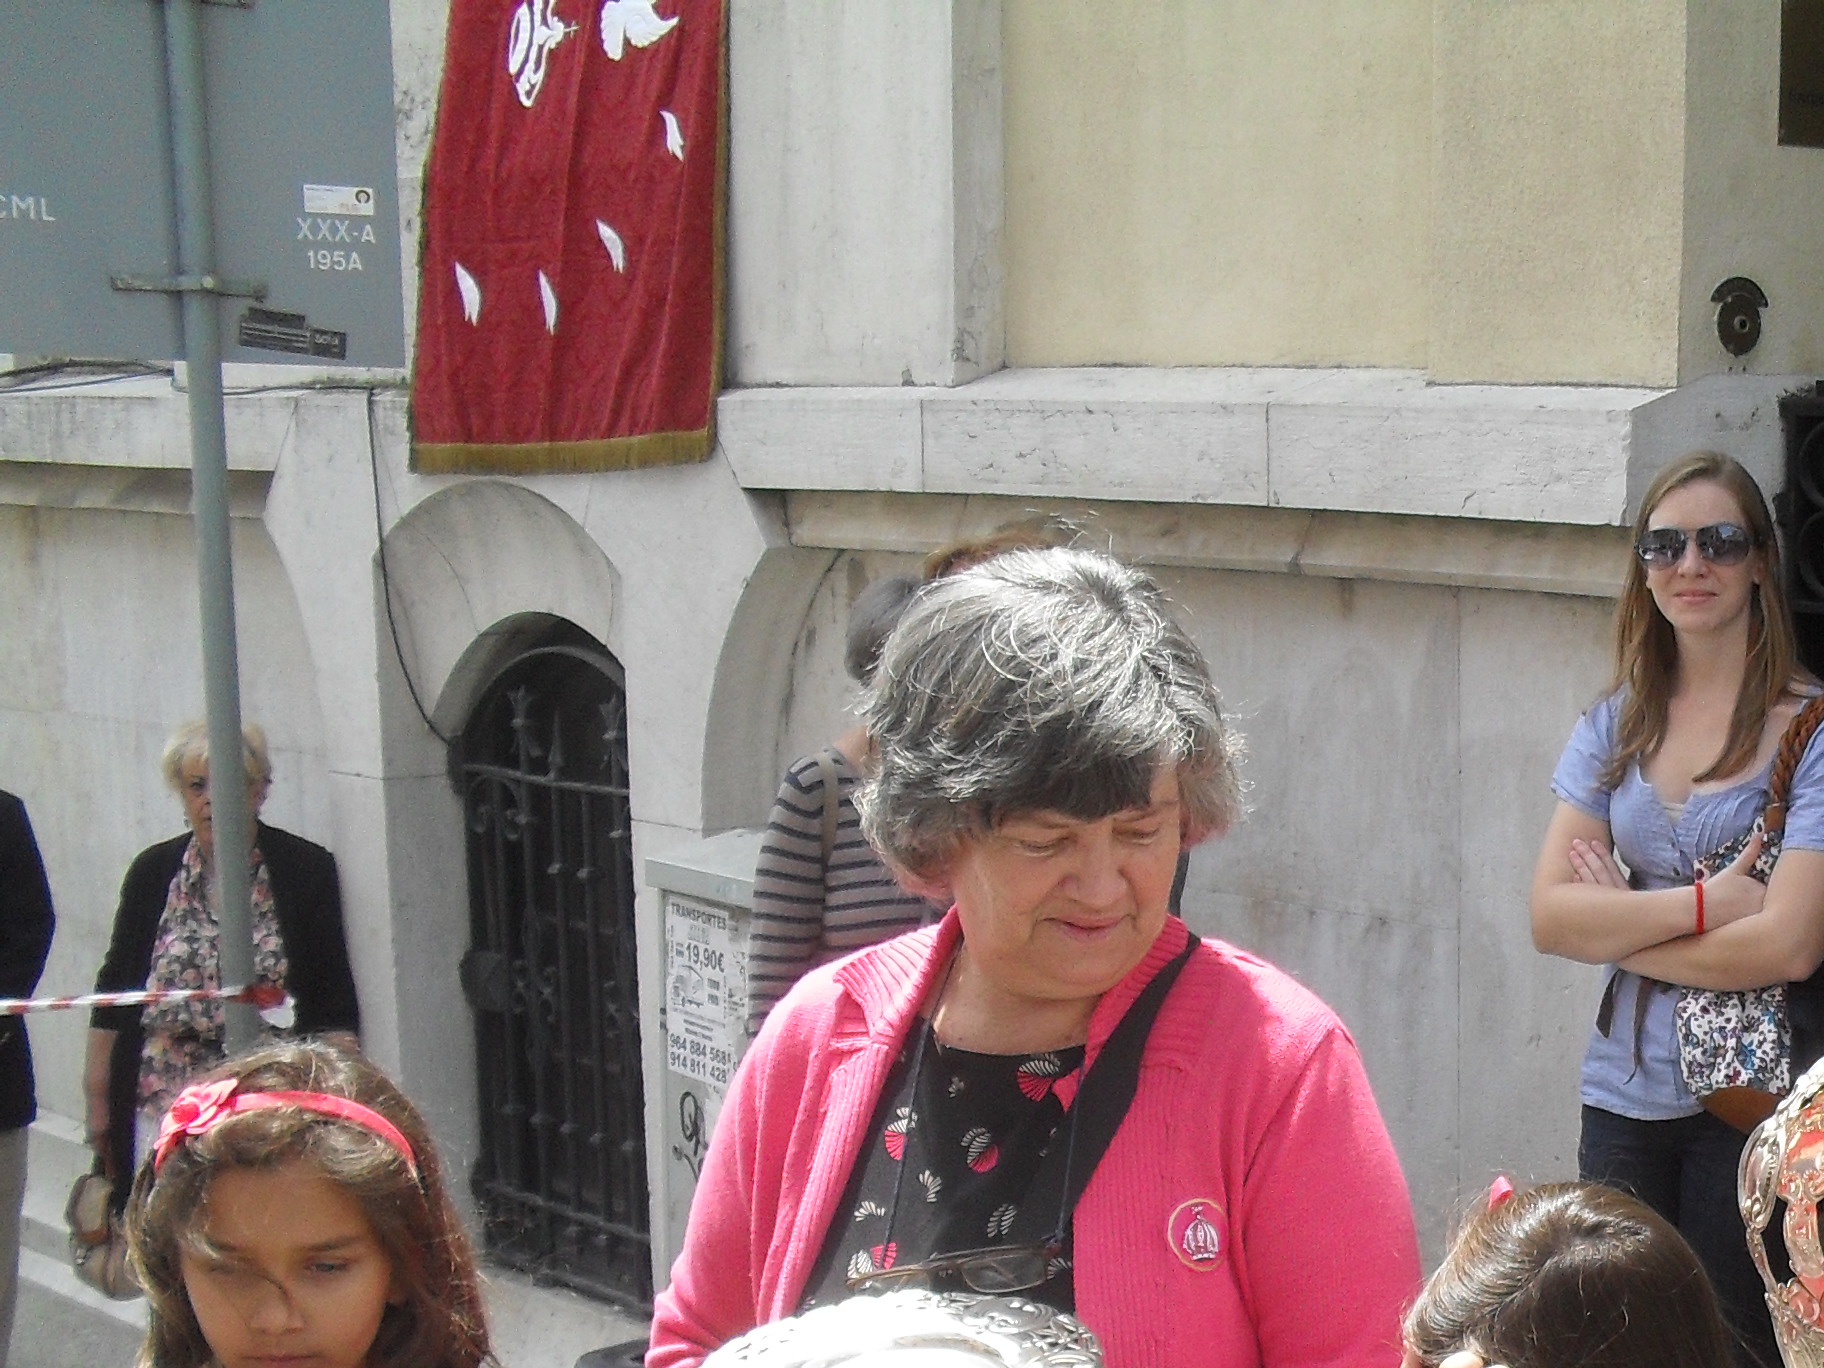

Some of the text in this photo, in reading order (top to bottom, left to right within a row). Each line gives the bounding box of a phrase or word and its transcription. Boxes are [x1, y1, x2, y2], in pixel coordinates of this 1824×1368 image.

[296, 217, 376, 244] XXX-A
[307, 249, 363, 271] 195A
[671, 902, 727, 931] TRANSPORTES
[685, 942, 725, 974] 19,90€
[670, 1032, 687, 1051] 964
[670, 1051, 688, 1070] 914
[690, 1058, 706, 1078] 811
